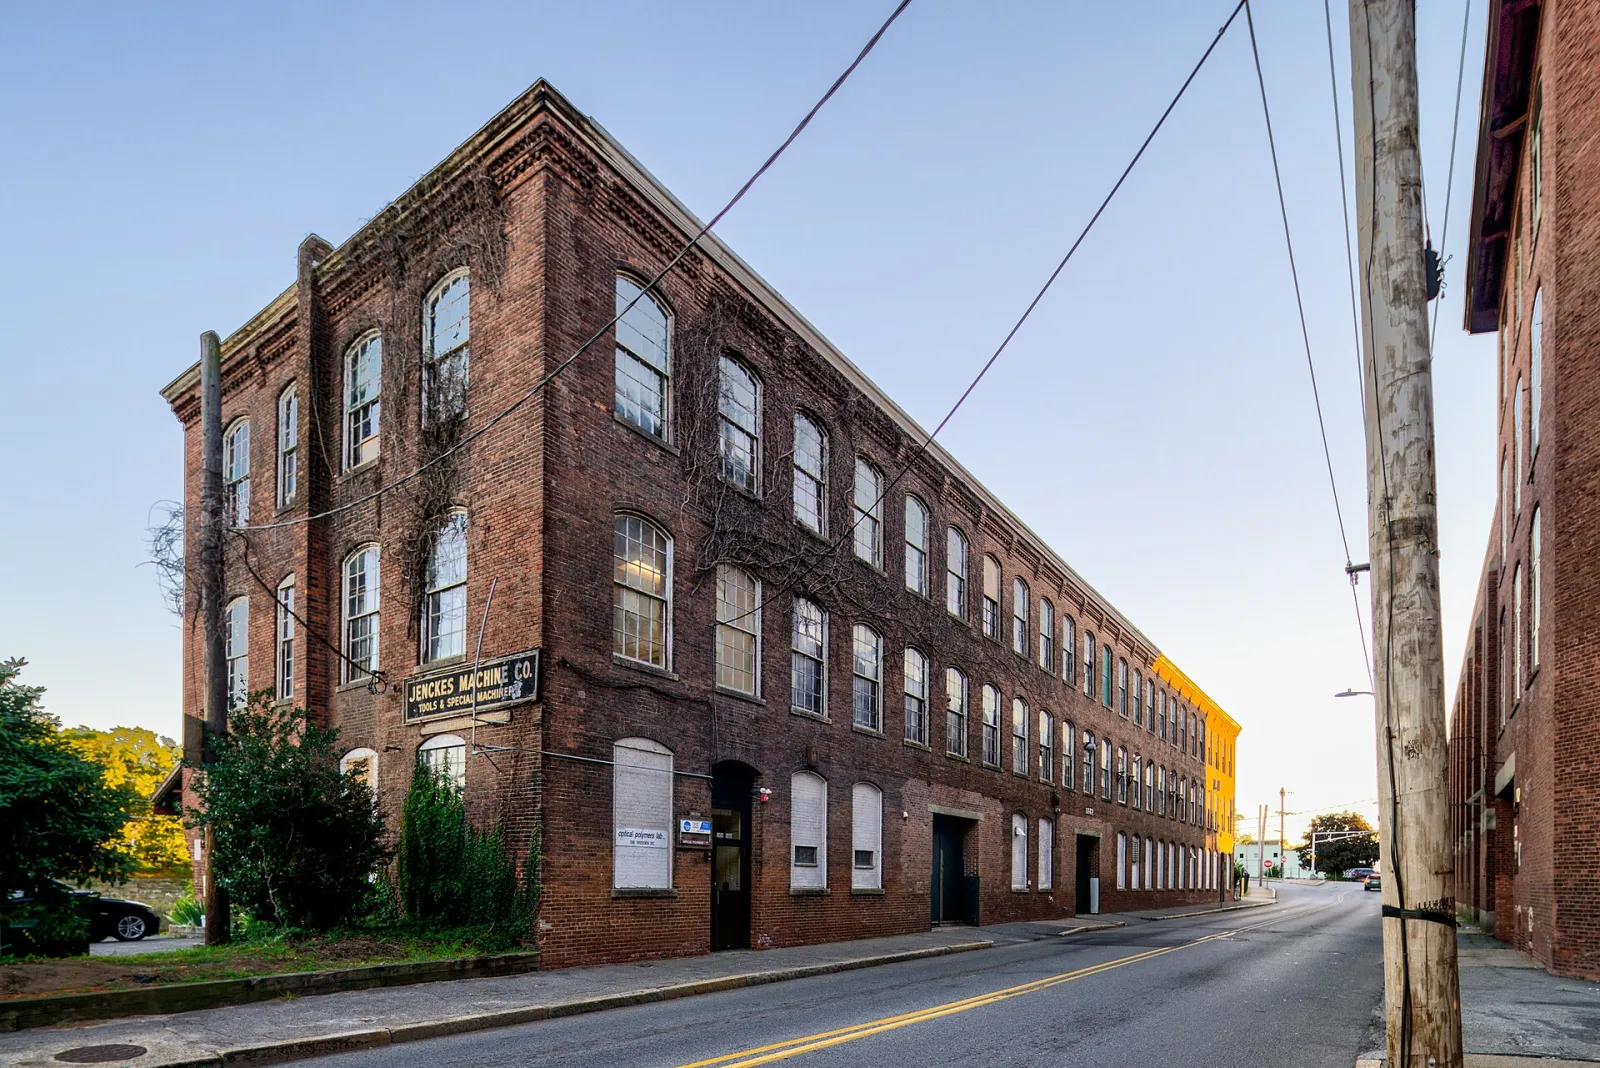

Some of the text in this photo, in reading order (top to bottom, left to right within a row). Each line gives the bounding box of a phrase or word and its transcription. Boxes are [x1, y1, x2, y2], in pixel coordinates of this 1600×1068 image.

[409, 660, 533, 703] JENCKES MACHINE CO.
[418, 686, 521, 713] TOOLS & SPECIAL MACHINER
[618, 830, 633, 838] optical
[635, 831, 655, 839] polymers
